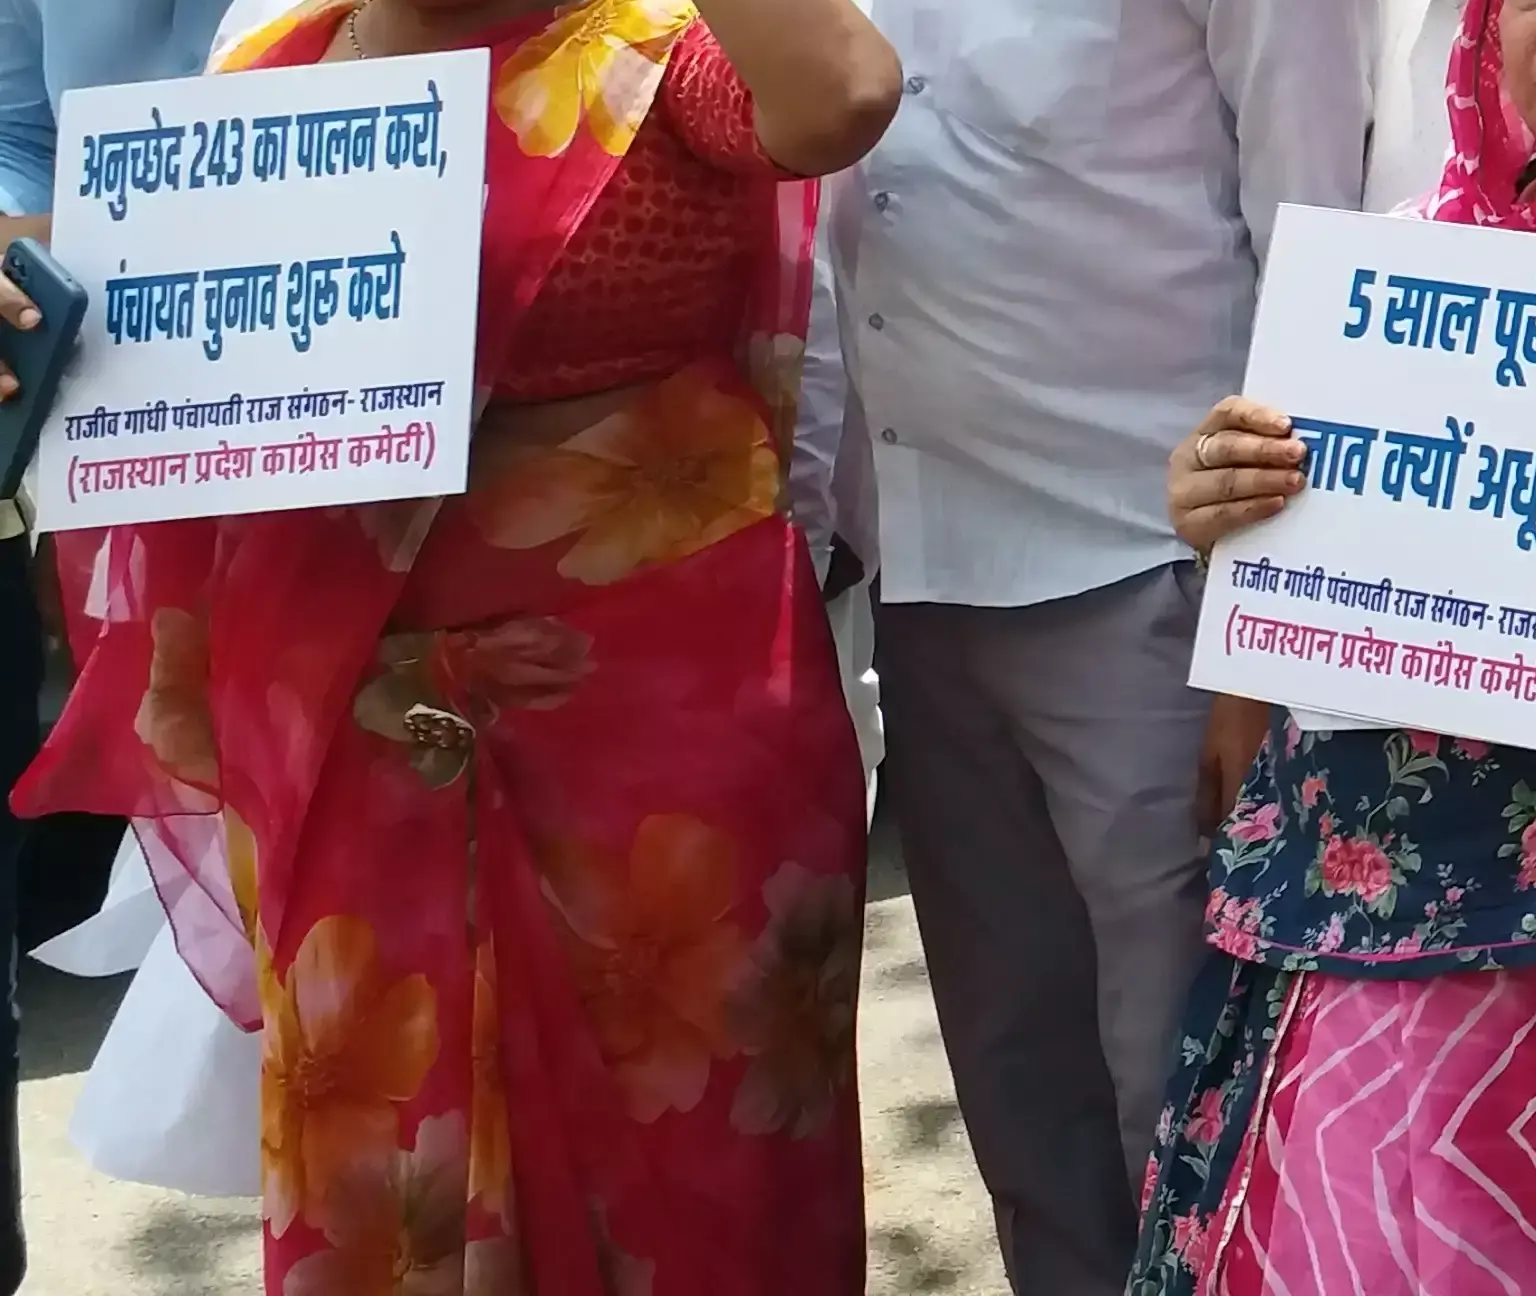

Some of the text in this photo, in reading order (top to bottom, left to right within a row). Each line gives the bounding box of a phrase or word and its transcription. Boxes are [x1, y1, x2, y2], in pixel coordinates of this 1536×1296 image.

[80, 79, 447, 221] अनुच्छेद 243 का पालन करो,
[105, 259, 199, 345] पंचायत
[203, 263, 281, 361] चुनाव
[347, 230, 406, 323] करो
[1343, 268, 1377, 340] 5
[1383, 274, 1491, 354] साल
[65, 406, 119, 441] राजीव
[123, 400, 169, 436] गांधी
[172, 393, 245, 431] पंचायती
[247, 395, 282, 423] राज
[360, 380, 445, 413] राजस्थान
[67, 421, 437, 504] (राजस्थान प्रदेश कांग्रेस कमेटी)
[1289, 415, 1379, 496] नाव
[1381, 415, 1475, 511] क्यों
[1231, 559, 1282, 595] राजीव
[1283, 562, 1325, 601] गांधी
[1326, 570, 1393, 611] पंचायती
[1394, 588, 1427, 620] राज
[1225, 604, 1339, 664] (राजस्थान
[1339, 625, 1397, 676] प्रदेश
[1400, 639, 1478, 691] कांग्रेस
